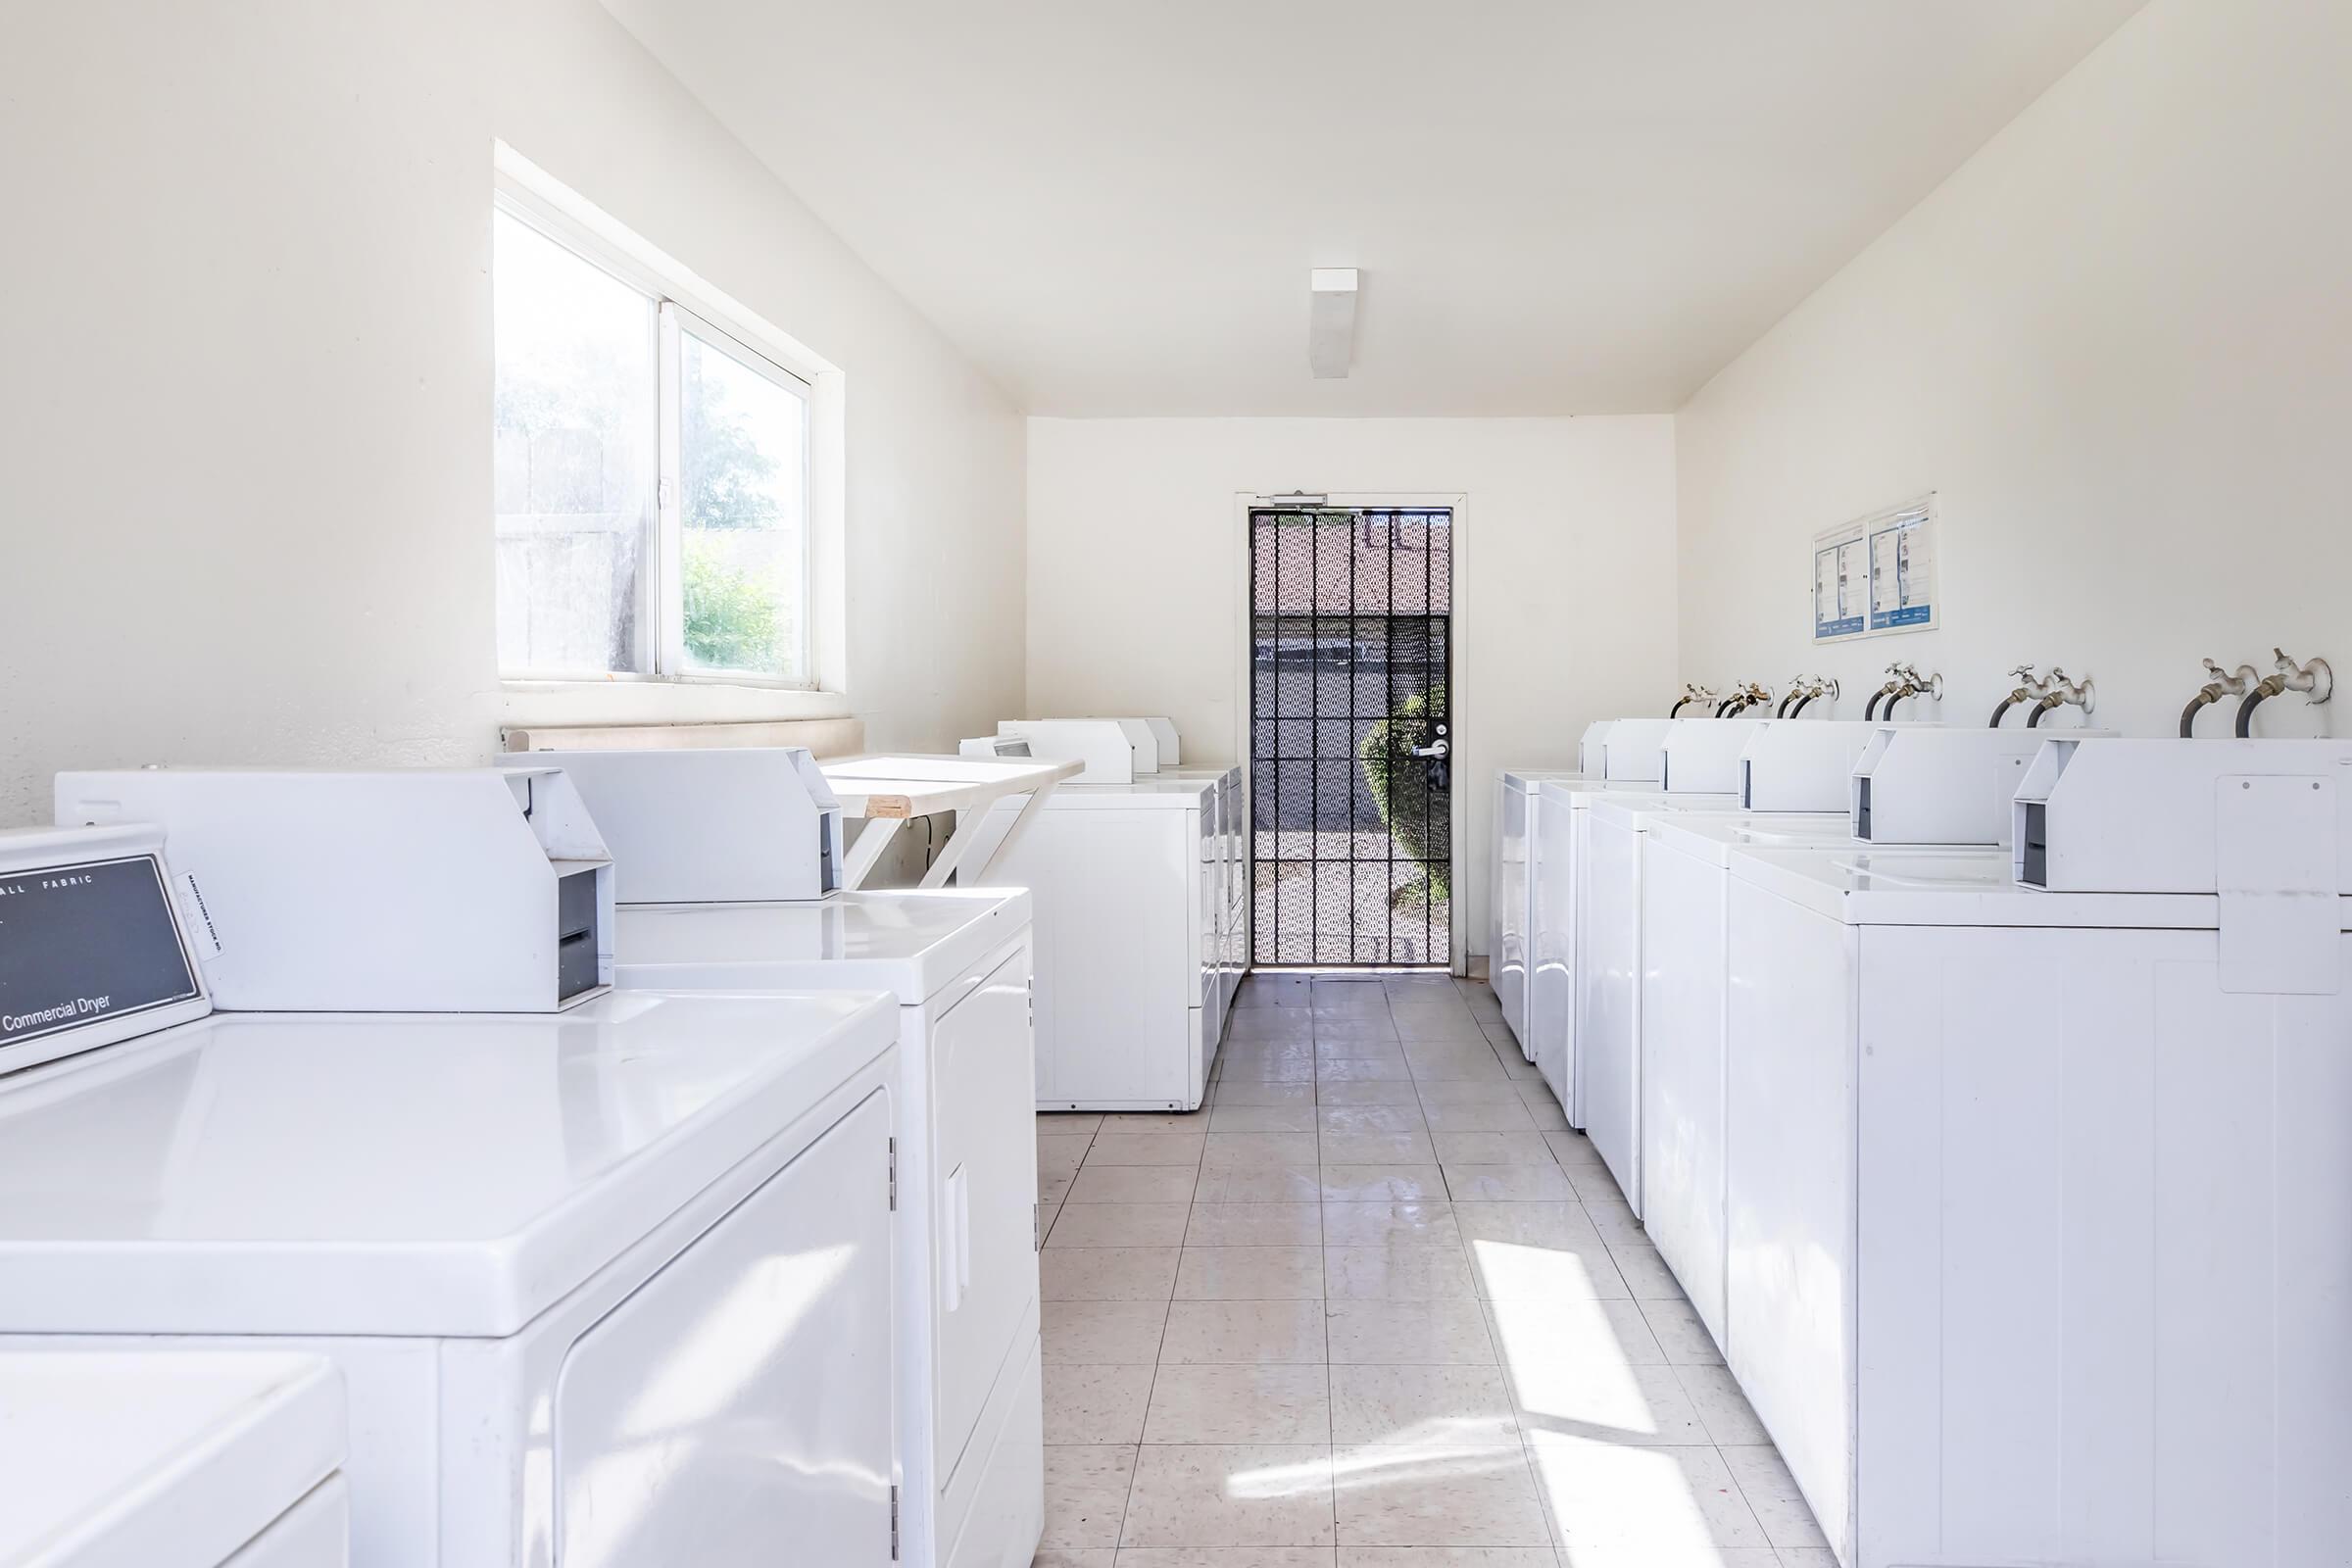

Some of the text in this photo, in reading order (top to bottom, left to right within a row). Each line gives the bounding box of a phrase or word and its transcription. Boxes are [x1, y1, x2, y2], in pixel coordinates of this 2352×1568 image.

[42, 875, 92, 889] FABRIC
[188, 874, 210, 921] MANUFACTURER
[207, 921, 218, 941] STOCK
[2, 994, 111, 1032] Commercial Dryer
